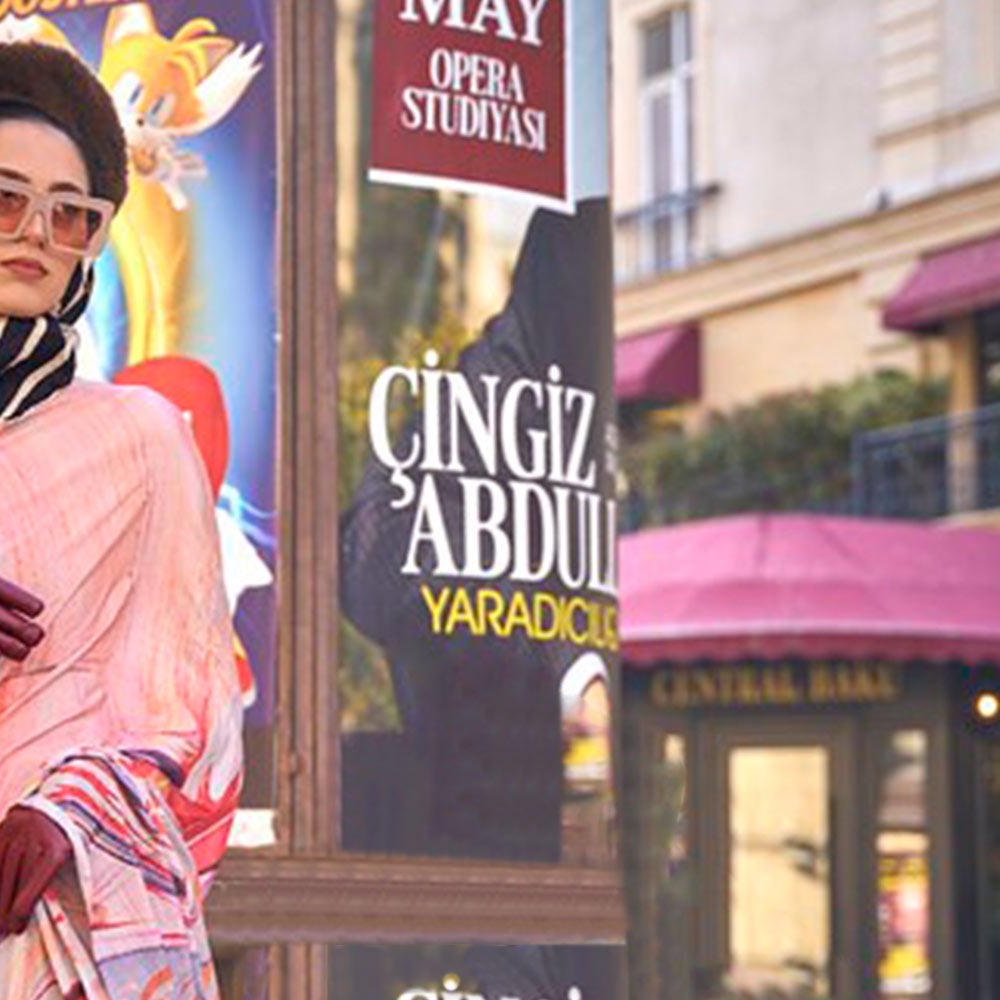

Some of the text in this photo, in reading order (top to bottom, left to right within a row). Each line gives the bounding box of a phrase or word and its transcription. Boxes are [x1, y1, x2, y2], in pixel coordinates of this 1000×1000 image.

[429, 47, 525, 104] OPERA
[401, 86, 546, 152] STUDIYASI
[368, 348, 596, 509] ÇİNGİZ
